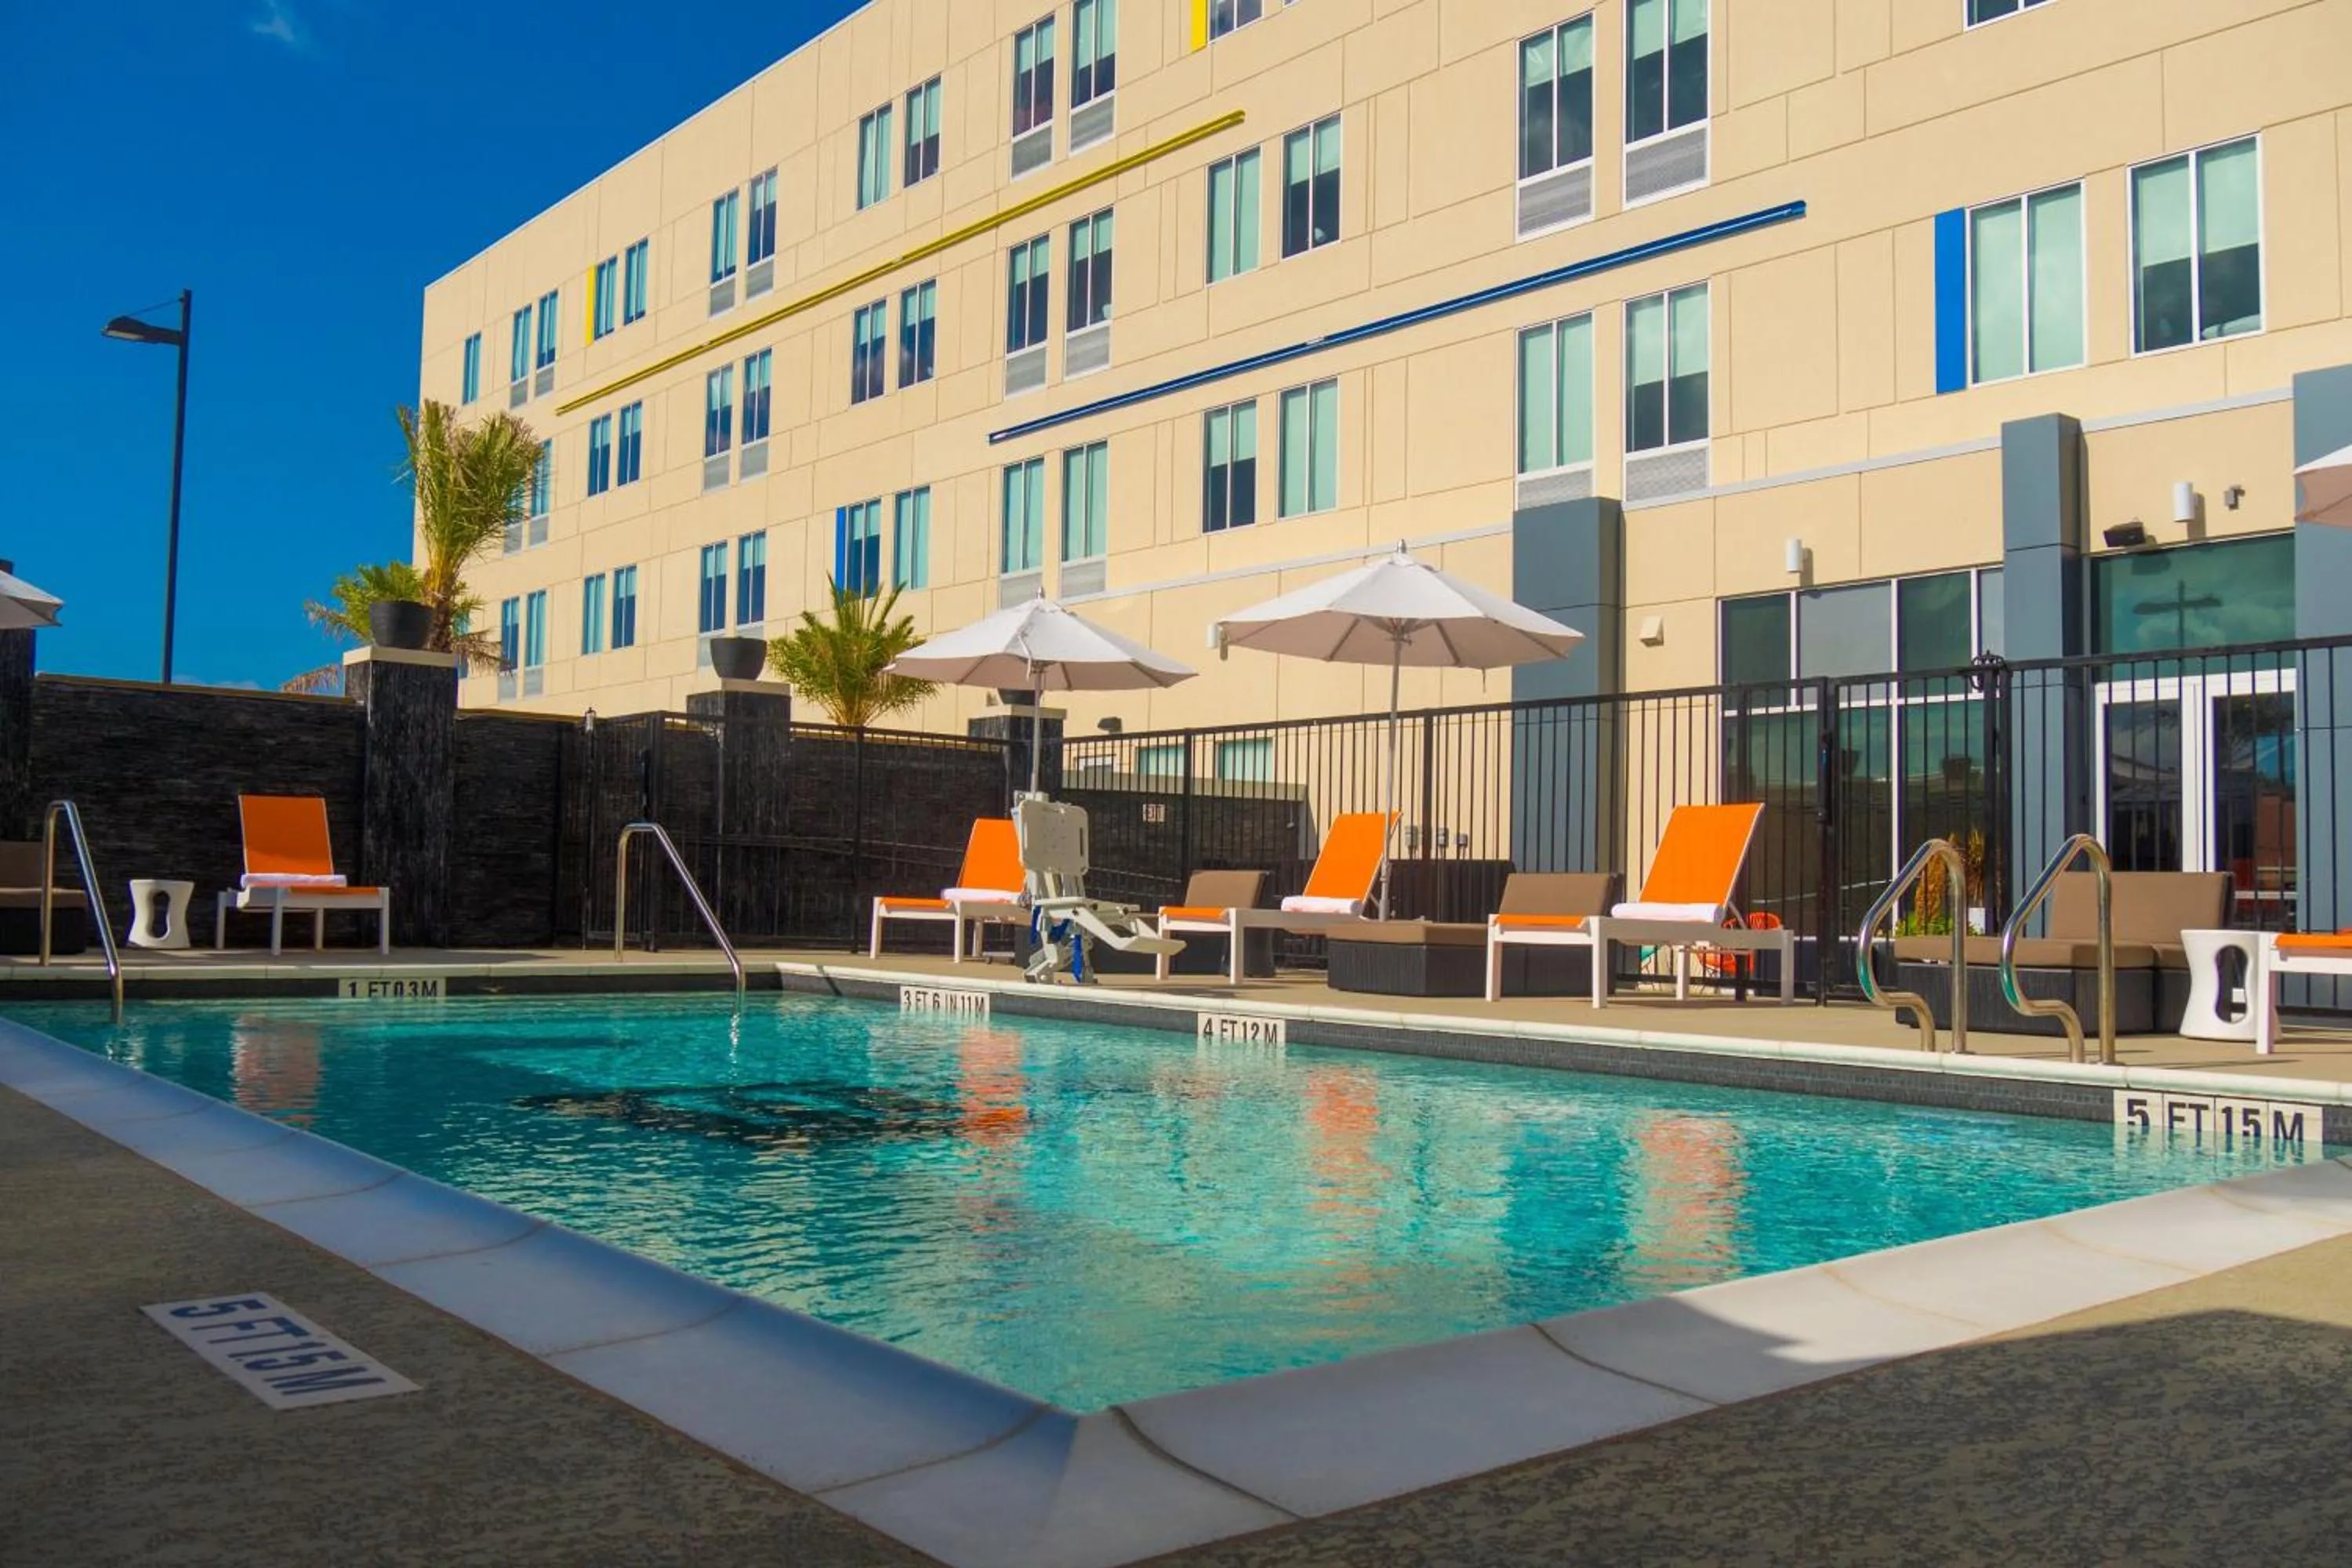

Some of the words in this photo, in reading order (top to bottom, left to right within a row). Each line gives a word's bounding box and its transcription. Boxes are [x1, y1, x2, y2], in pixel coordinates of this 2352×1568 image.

[904, 990, 911, 1010] 3
[1203, 1018, 1213, 1040] 4
[2127, 1099, 2150, 1134] 5
[169, 1298, 268, 1319] 5
